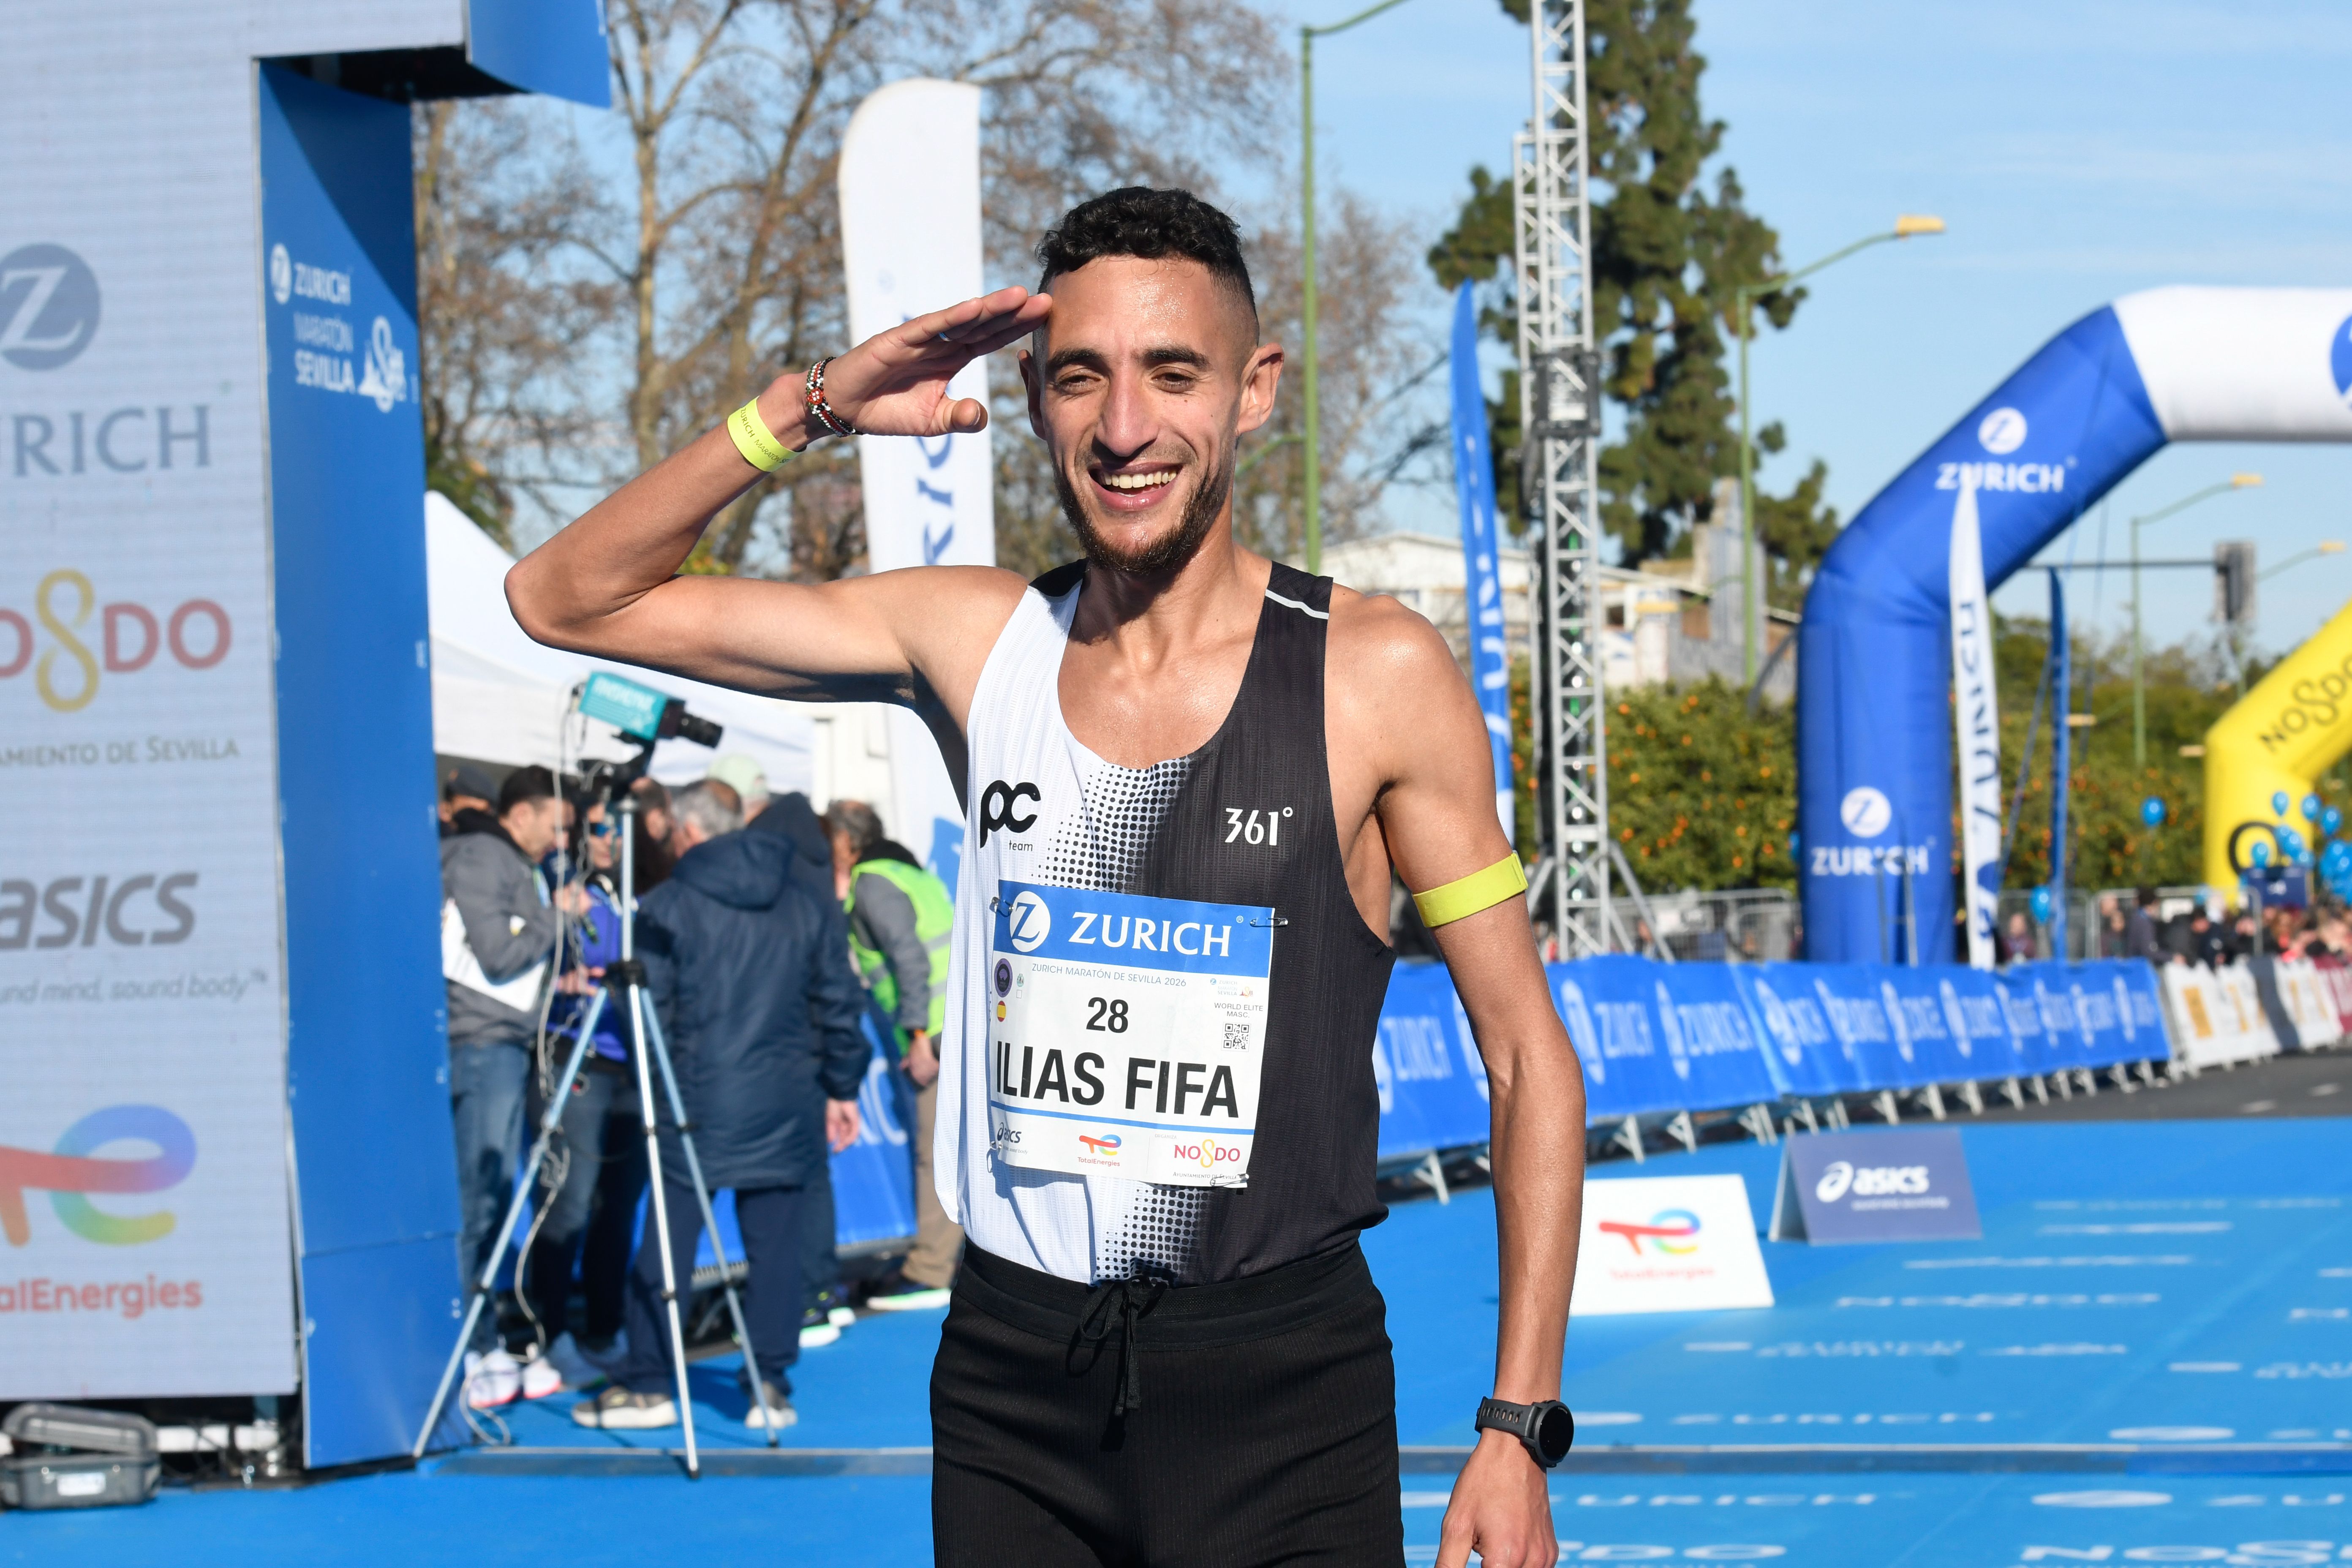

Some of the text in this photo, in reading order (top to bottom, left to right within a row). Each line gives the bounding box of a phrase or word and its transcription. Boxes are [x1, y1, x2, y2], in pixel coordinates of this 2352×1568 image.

[294, 349, 356, 395] SEVILLA
[12, 404, 211, 479] RICH
[740, 407, 755, 438] ZURICH
[1008, 840, 1034, 852] team
[0, 872, 199, 950] asics
[1068, 912, 1232, 957] ZURICH
[1032, 963, 1186, 987] ZURICH MARATÓN DE SEVILLA 2026
[1086, 997, 1129, 1034] 28
[996, 1040, 1239, 1119] ILIAS FIFA
[1078, 1157, 1120, 1167] TotalEnergies
